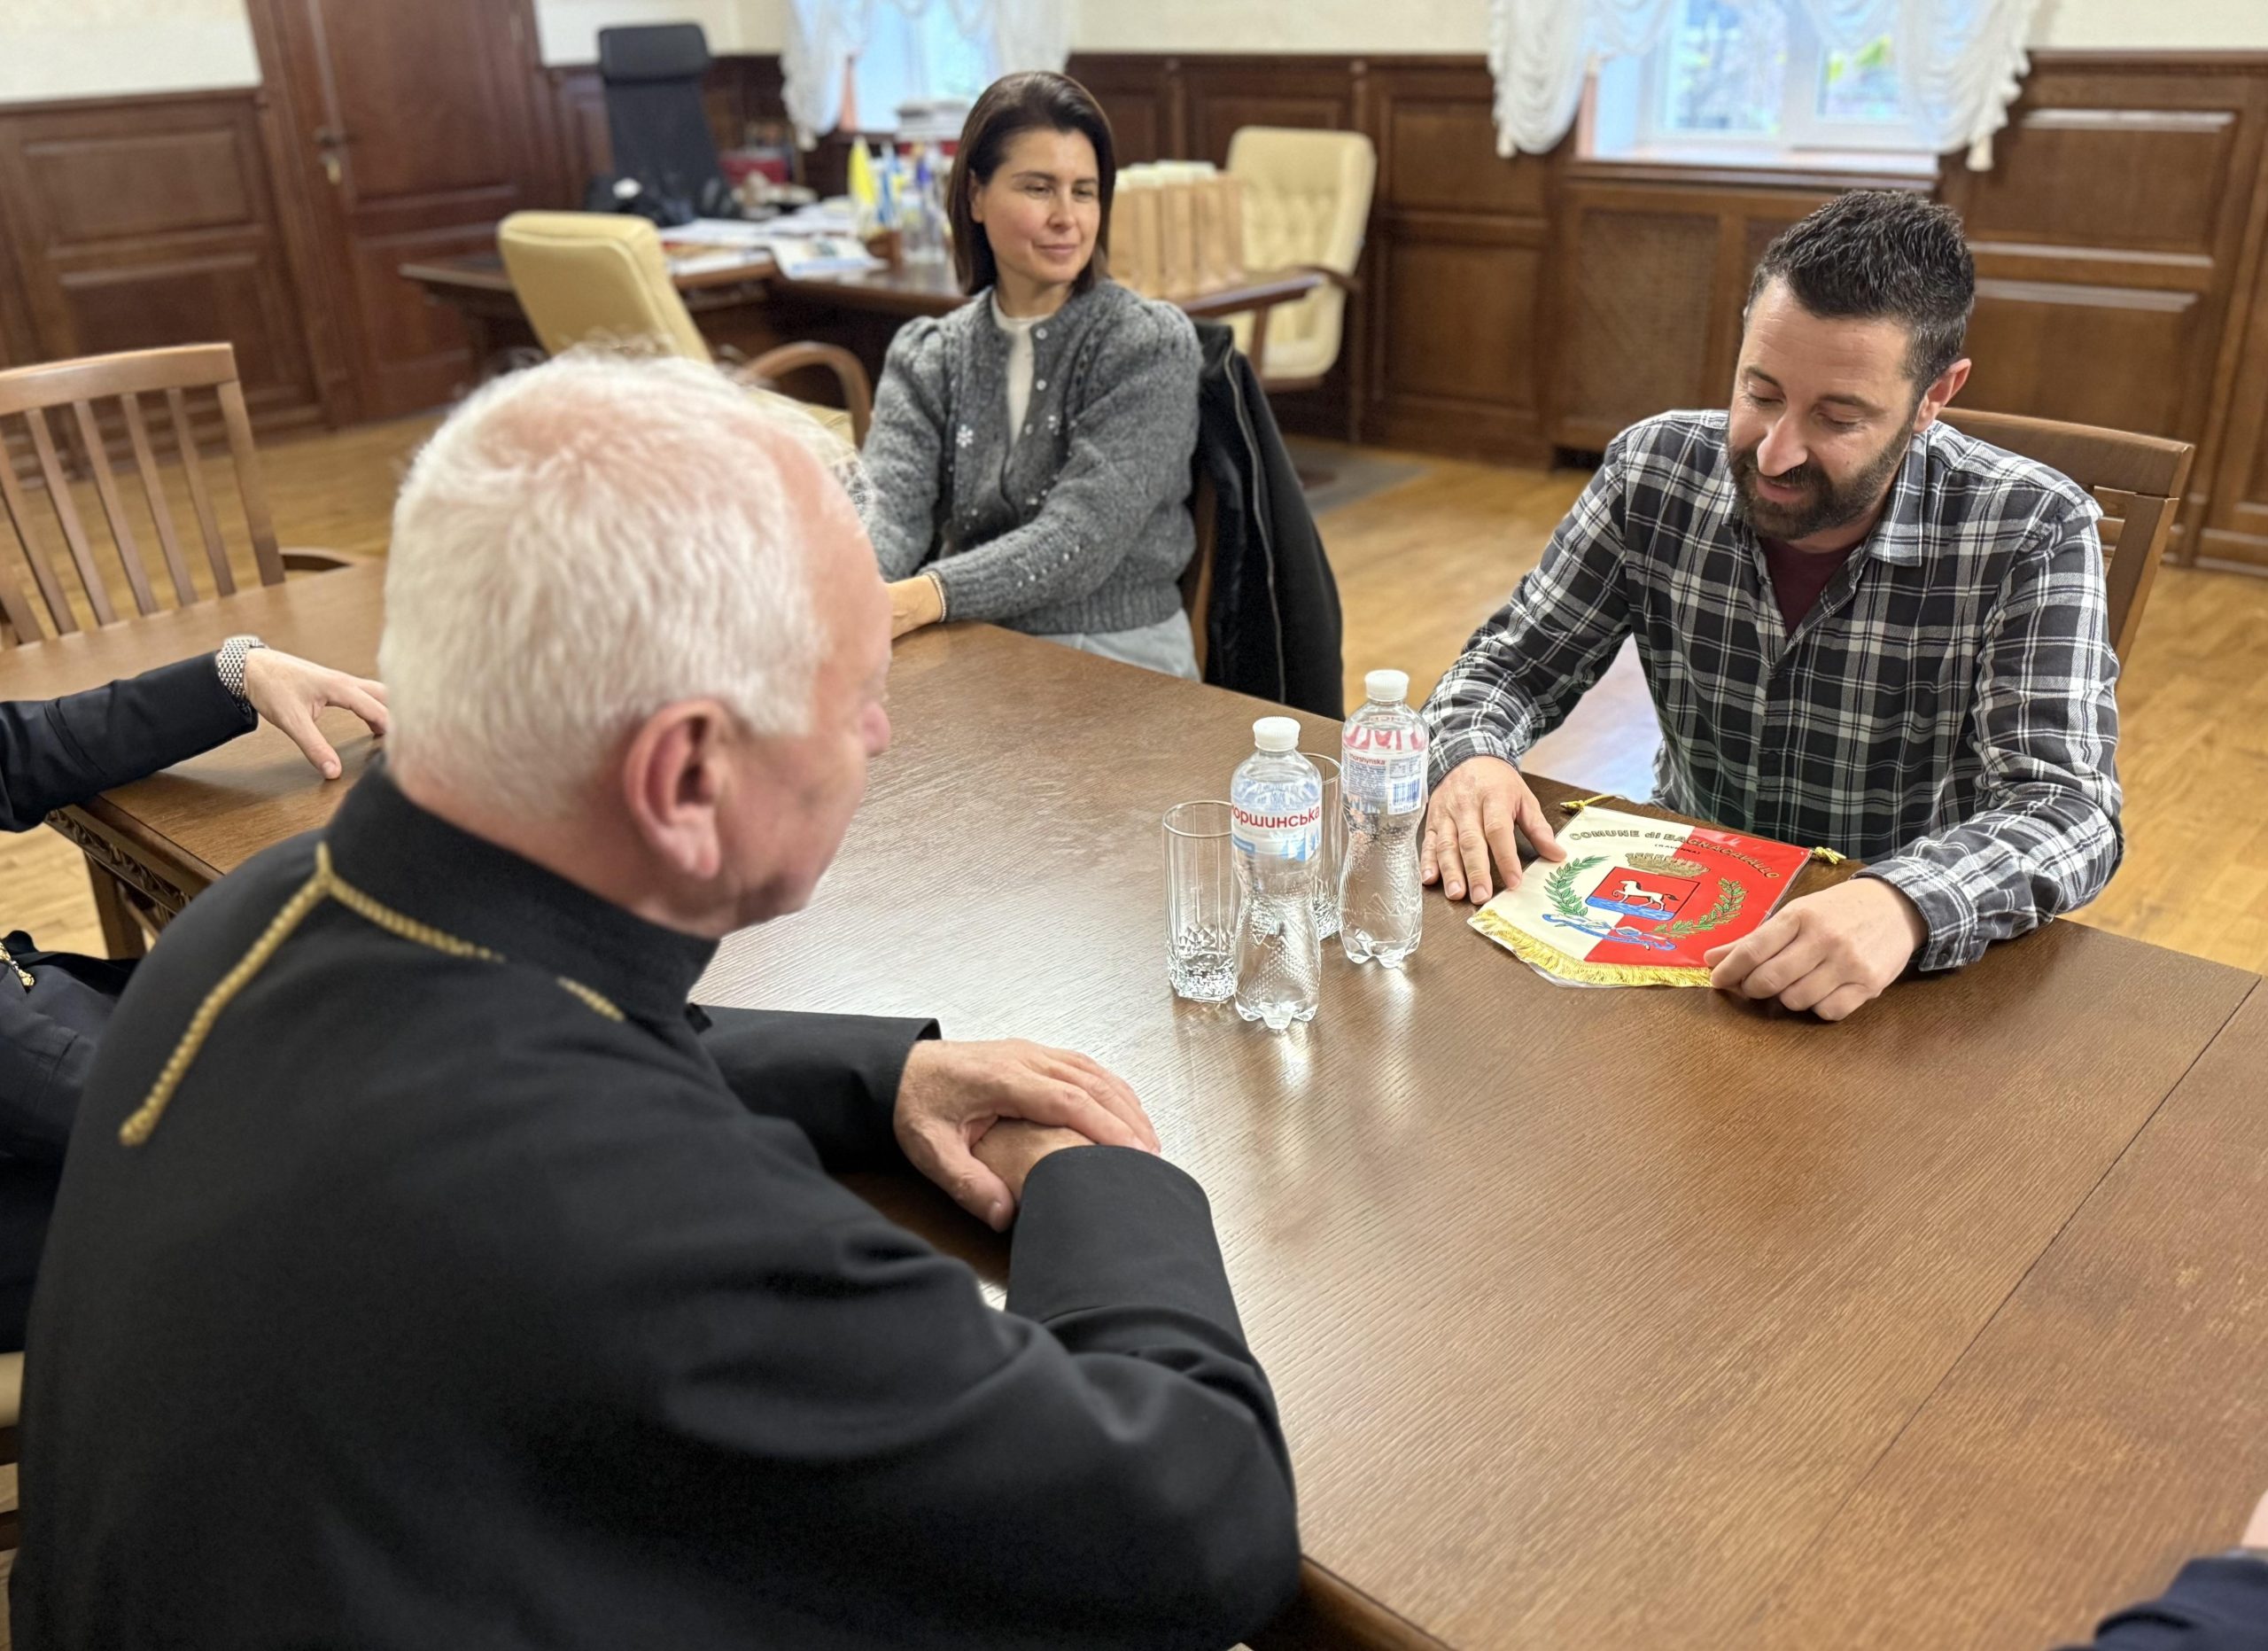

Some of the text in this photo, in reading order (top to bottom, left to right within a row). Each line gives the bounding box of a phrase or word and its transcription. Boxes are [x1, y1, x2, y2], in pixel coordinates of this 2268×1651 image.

[1232, 806, 1319, 828] оршинська
[1570, 830, 1639, 840] COMUNE
[1663, 833, 1780, 878] BAGNACAVALLO
